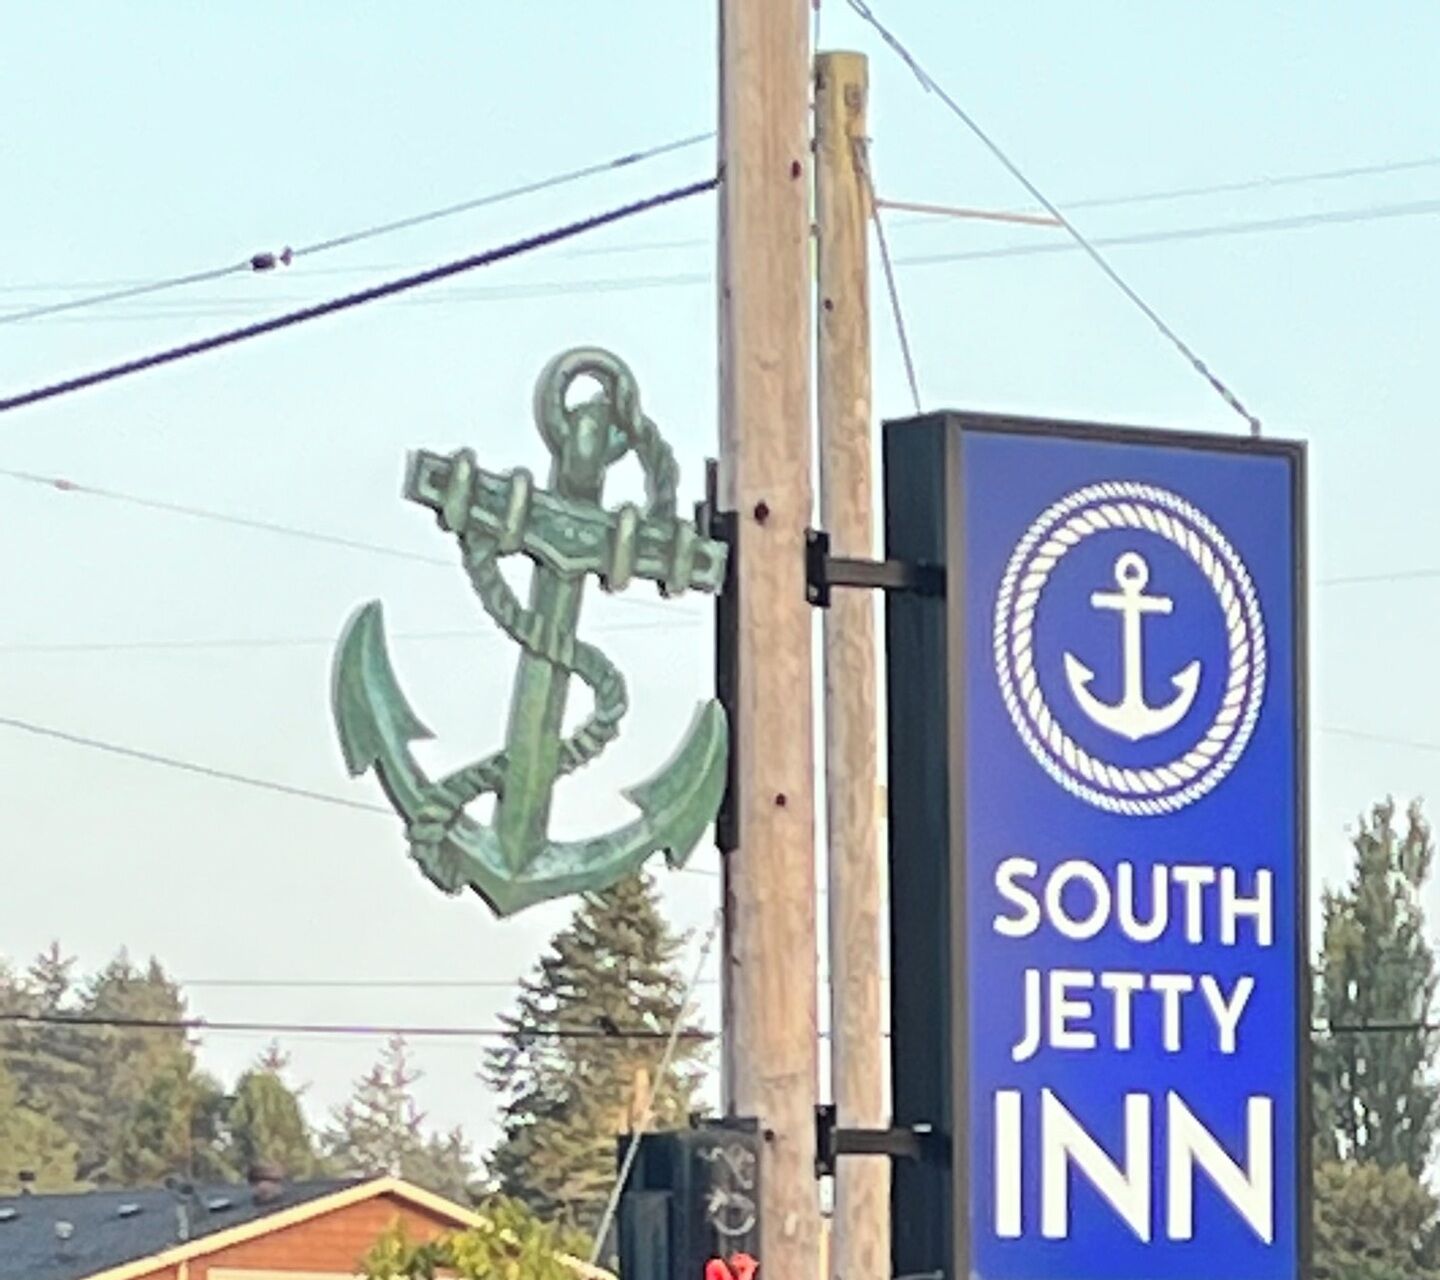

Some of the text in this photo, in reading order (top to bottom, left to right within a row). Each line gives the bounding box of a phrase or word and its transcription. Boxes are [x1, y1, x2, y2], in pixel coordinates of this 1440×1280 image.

[993, 857, 1273, 947] SOUTH
[1011, 968, 1255, 1063] JETTY
[995, 1087, 1273, 1246] INN
